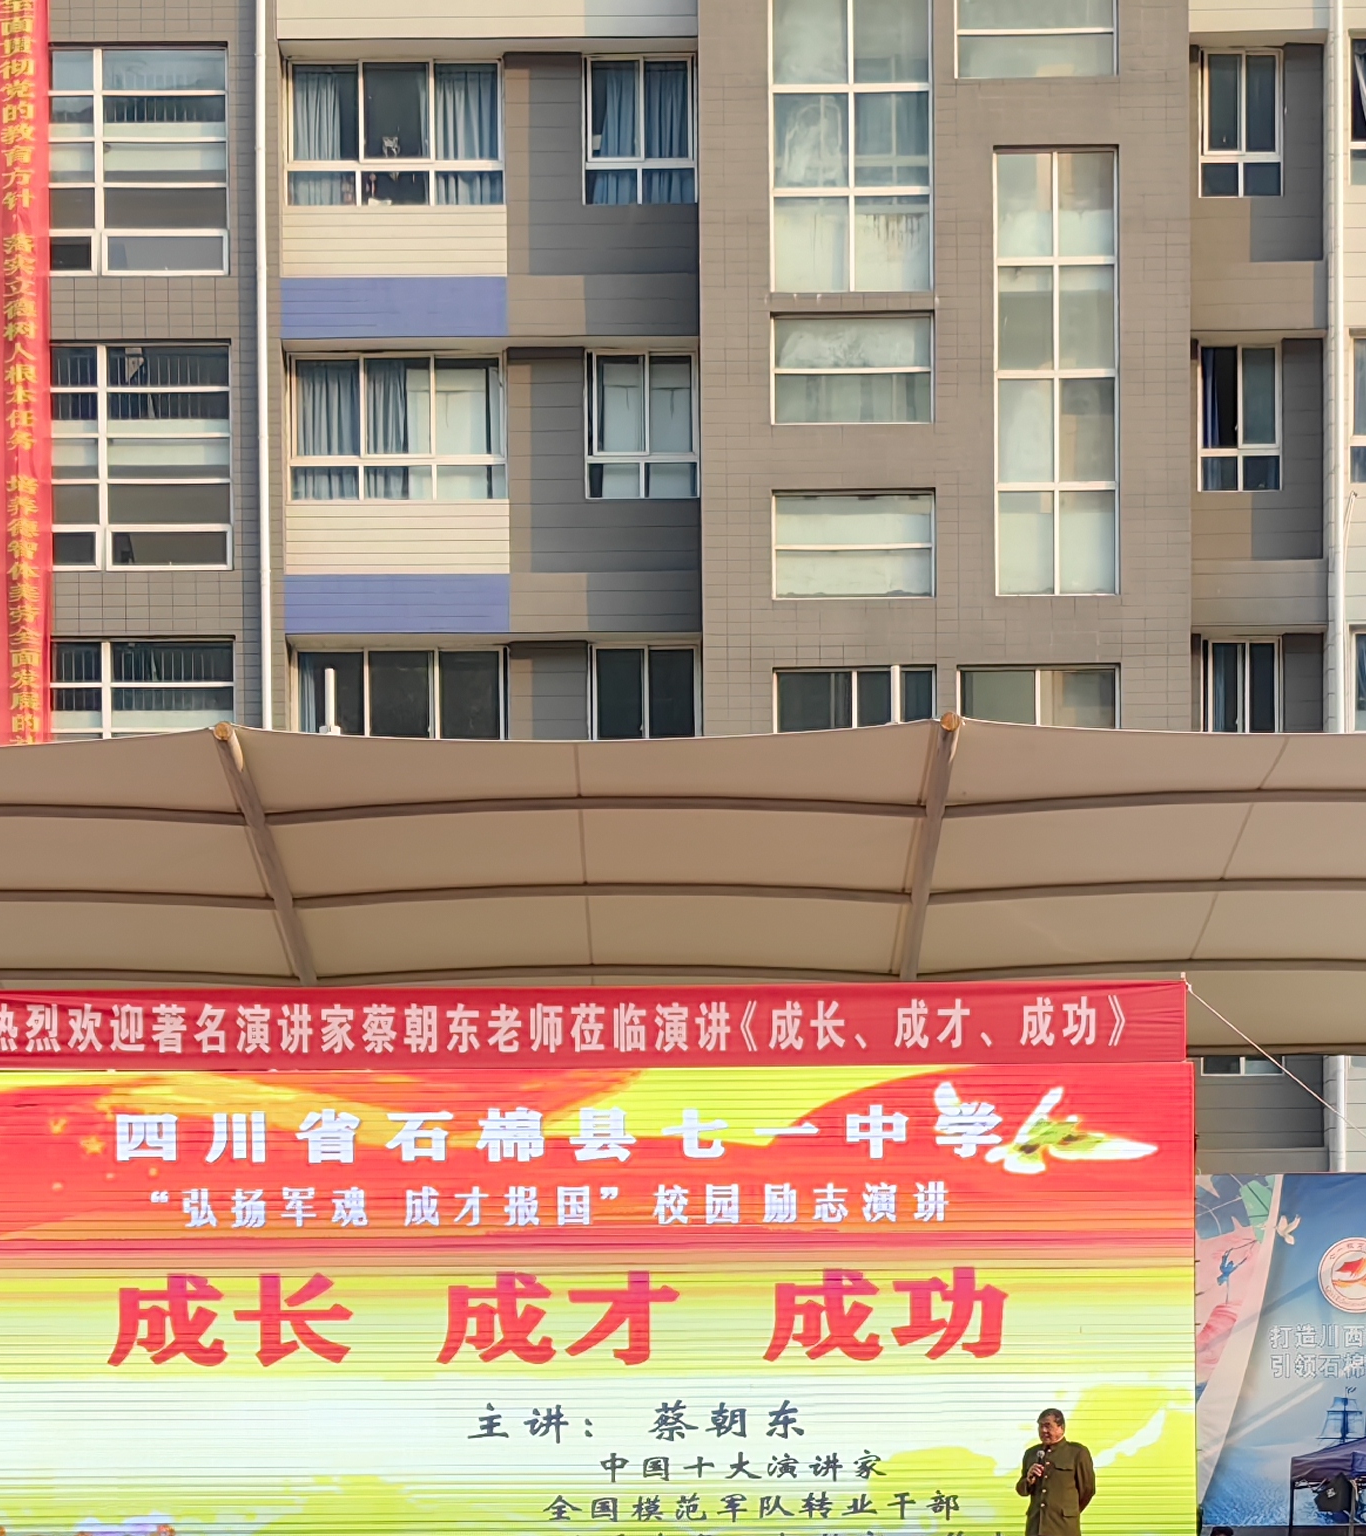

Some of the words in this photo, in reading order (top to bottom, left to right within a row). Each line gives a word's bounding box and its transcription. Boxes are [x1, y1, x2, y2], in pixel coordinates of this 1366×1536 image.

[115, 1102, 1002, 1164] 四川省石棉县七一中学
[652, 1181, 949, 1224] 校园励志演讲
[107, 1273, 354, 1367] 成长
[437, 1270, 680, 1366] 成才
[763, 1267, 1009, 1362] 成功
[648, 1399, 806, 1441] 蔡朝东
[600, 1449, 887, 1483] 中国十大演讲家
[542, 1490, 960, 1523] 全国模范军队转业干部
